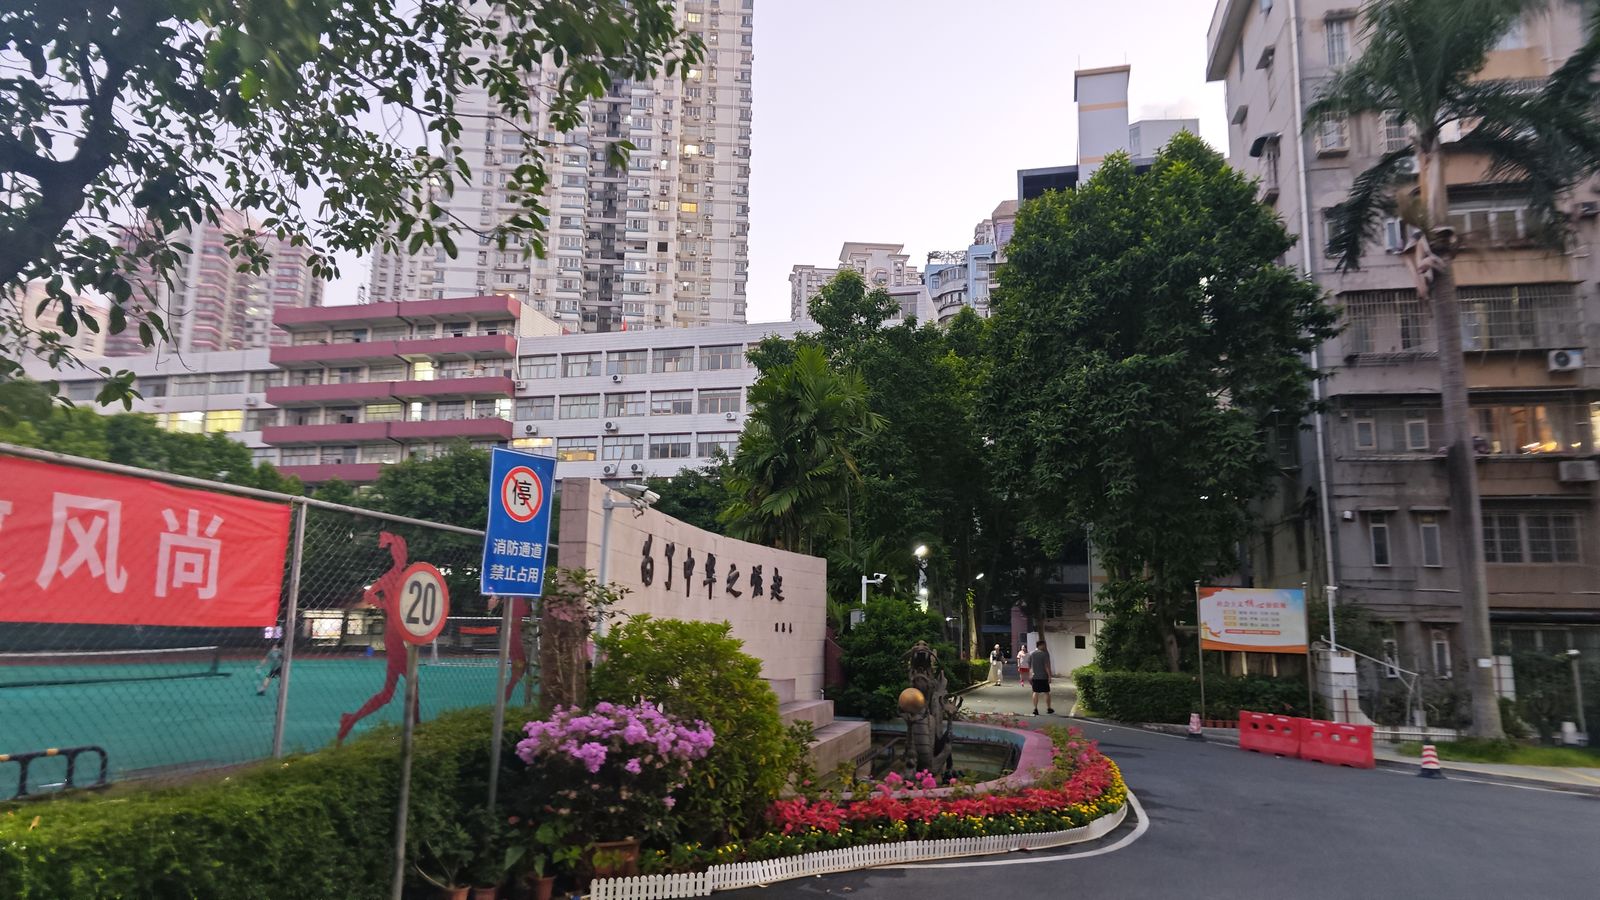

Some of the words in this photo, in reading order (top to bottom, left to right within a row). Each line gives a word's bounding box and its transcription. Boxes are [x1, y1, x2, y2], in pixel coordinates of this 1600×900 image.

[513, 479, 532, 506] 停
[0, 491, 224, 600] 风尚
[493, 538, 543, 559] 消防通道
[490, 564, 540, 583] 禁止占用
[405, 580, 437, 626] 20
